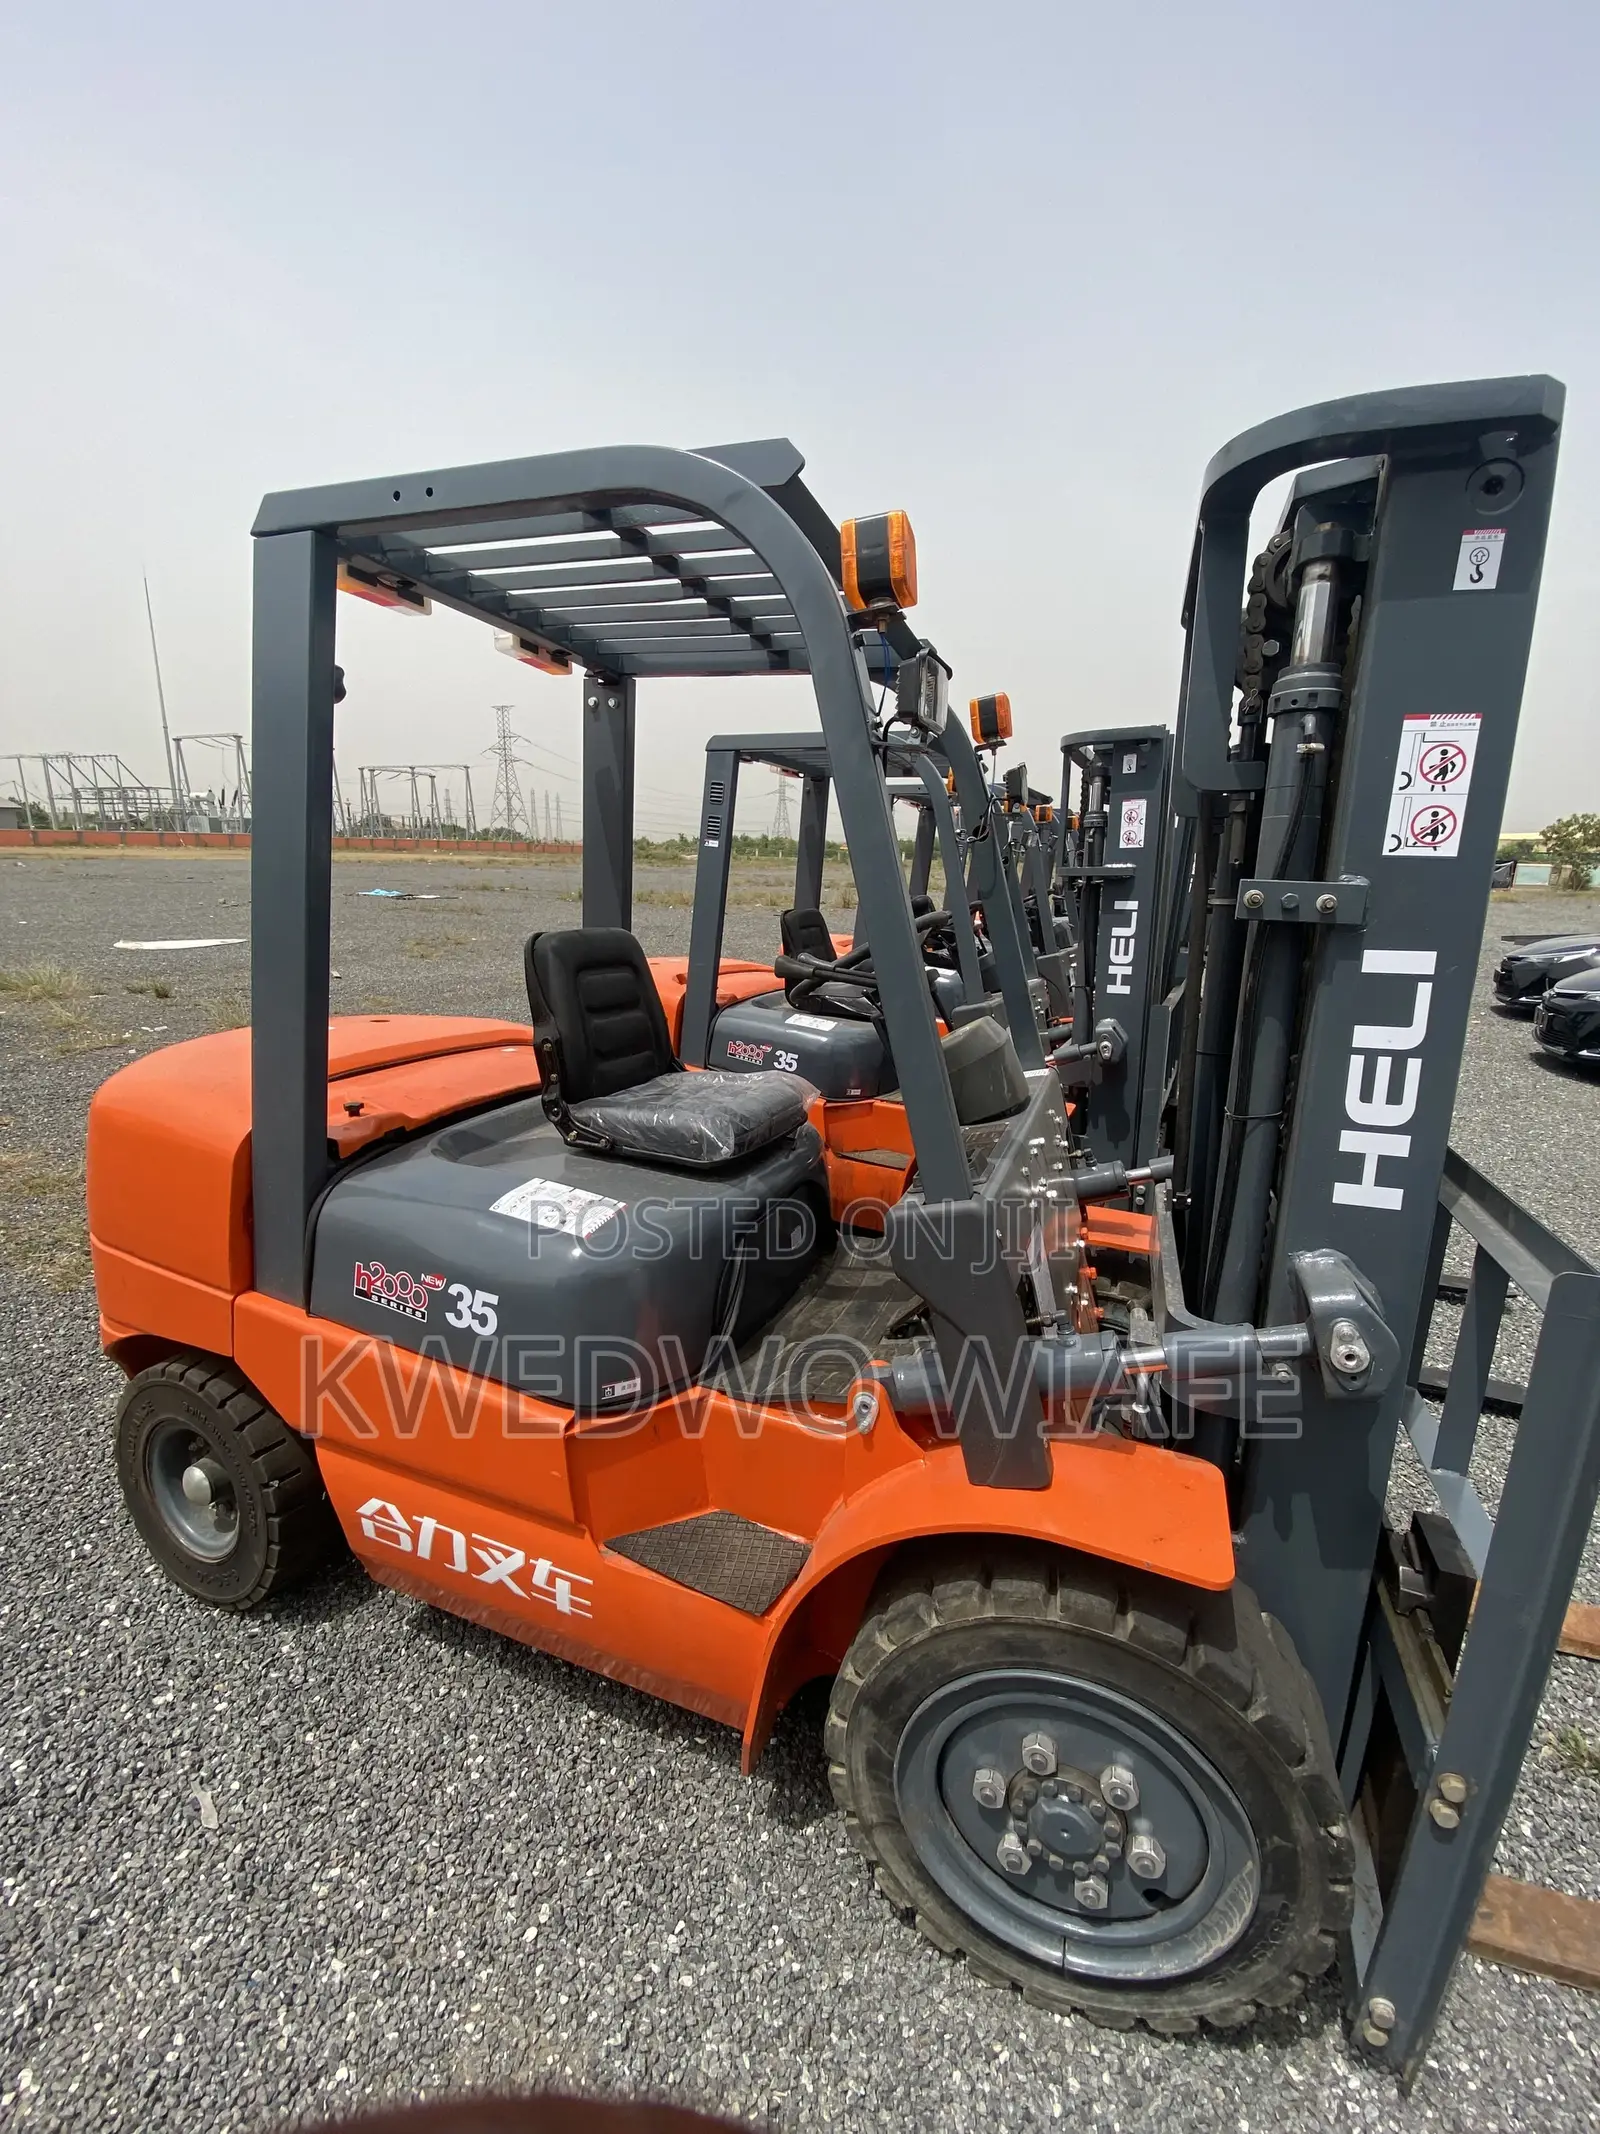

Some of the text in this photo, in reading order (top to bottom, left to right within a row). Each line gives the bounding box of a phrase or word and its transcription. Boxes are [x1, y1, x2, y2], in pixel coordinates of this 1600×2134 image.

[1106, 900, 1139, 995] HELI
[773, 1049, 799, 1072] 35
[1332, 949, 1438, 1211] HELI
[370, 1294, 424, 1319] SERIES
[420, 1272, 444, 1288] NEW
[445, 1283, 500, 1336] 35
[355, 1497, 594, 1619] 合力叉车
